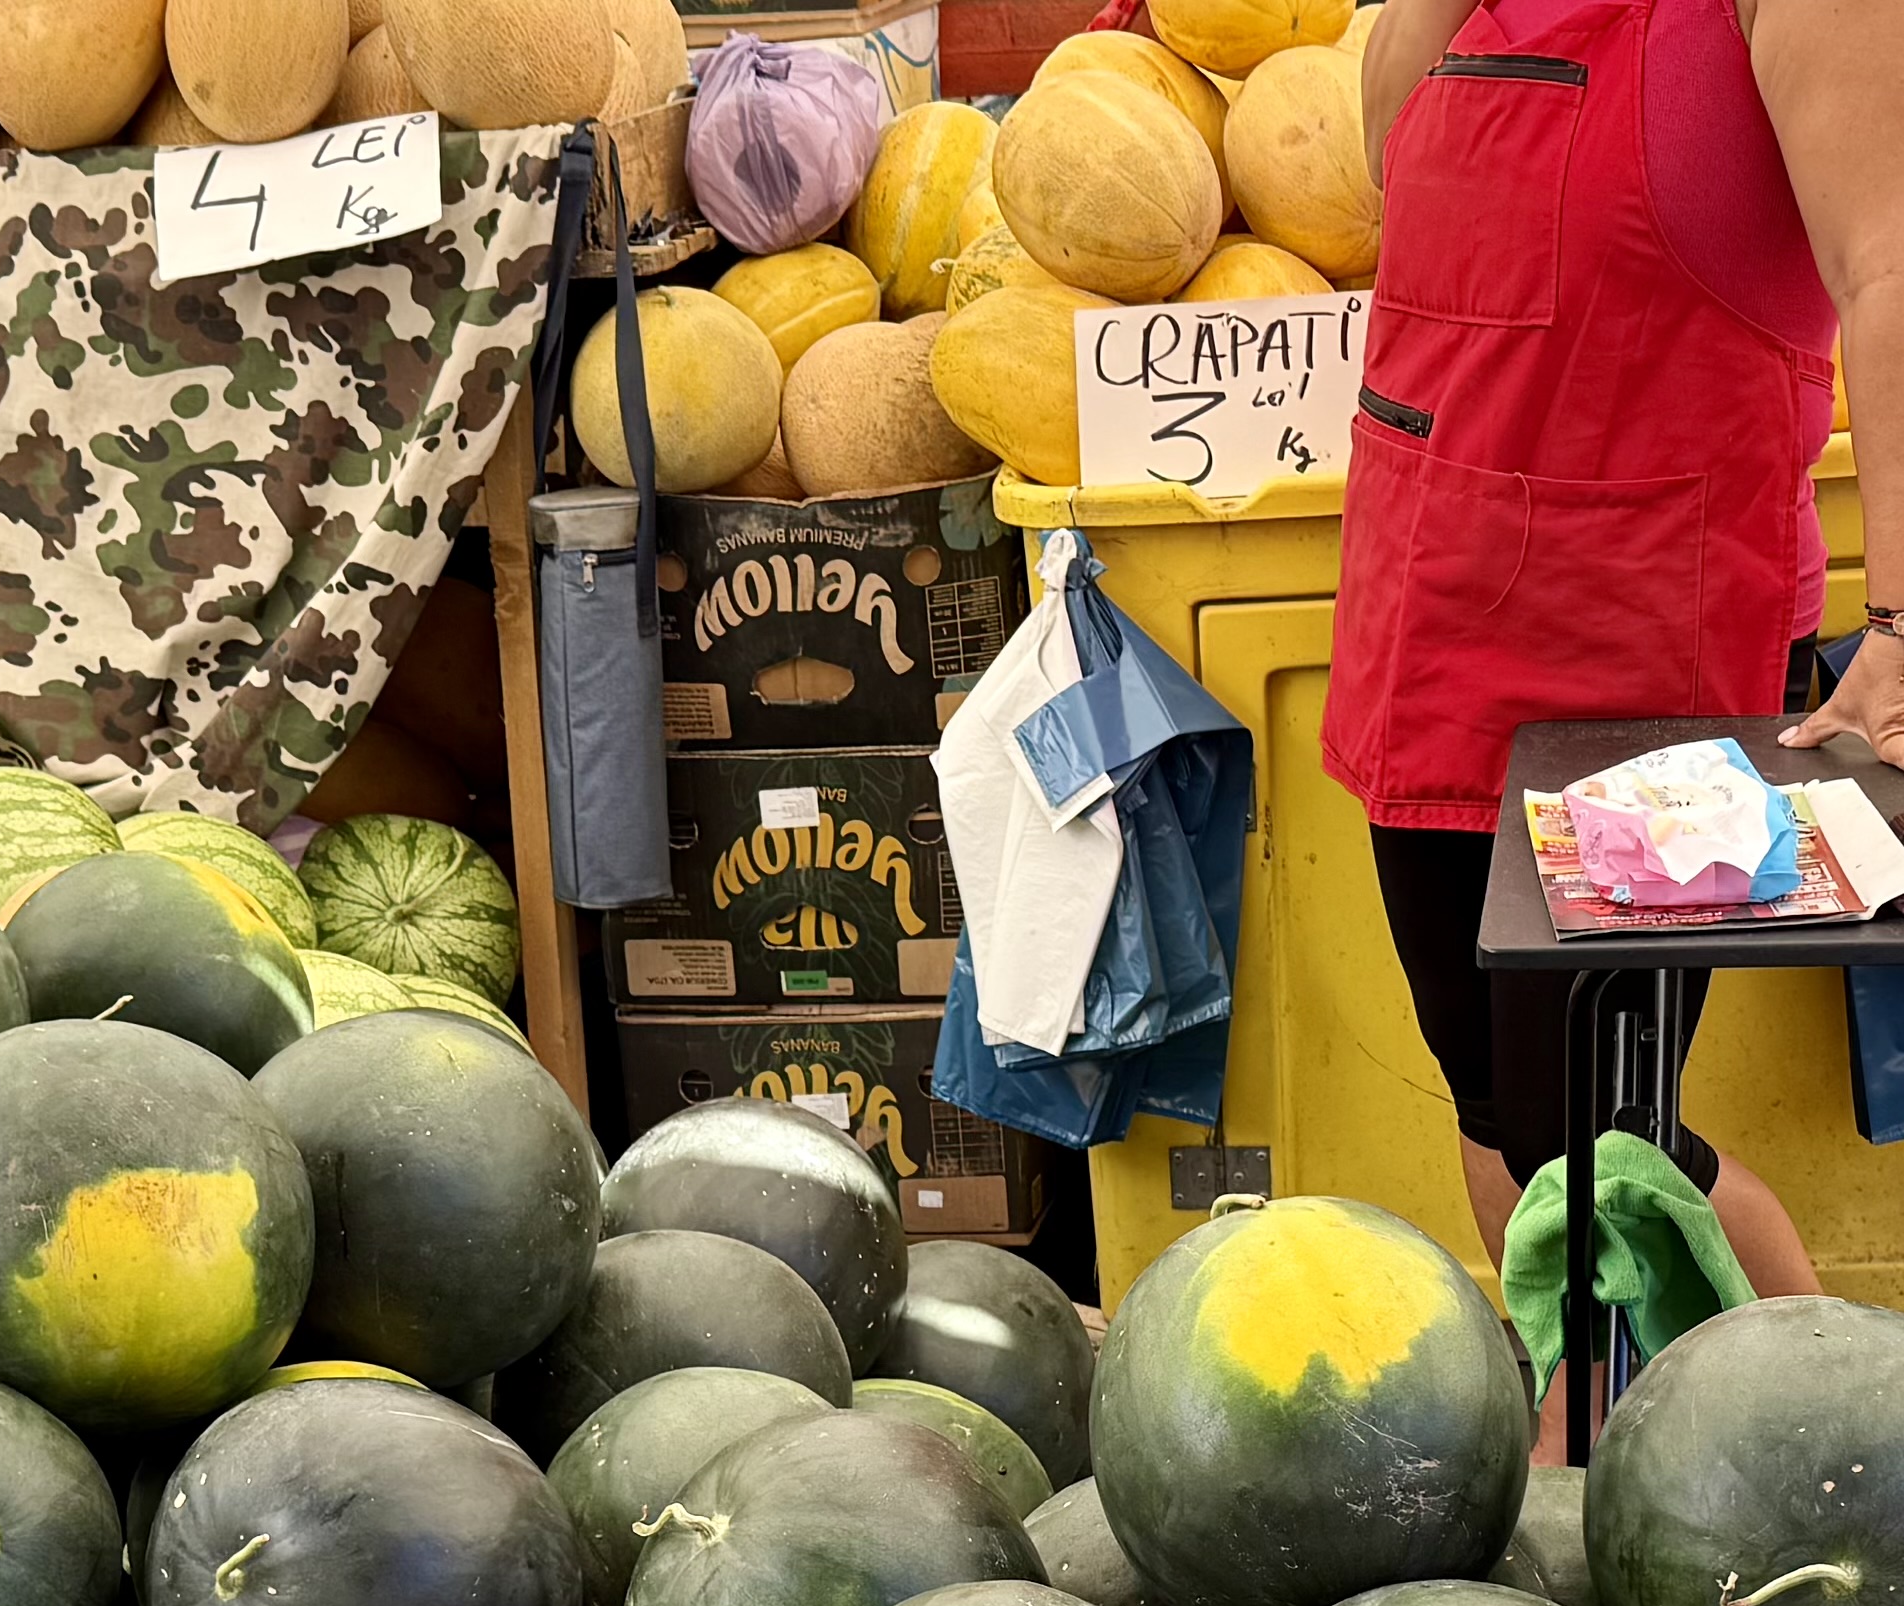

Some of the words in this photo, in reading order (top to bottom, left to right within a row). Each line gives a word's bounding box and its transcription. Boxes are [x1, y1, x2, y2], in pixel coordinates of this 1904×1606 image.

[191, 150, 268, 251] 4
[312, 114, 426, 168] LEI
[1147, 391, 1226, 486] 3
[716, 527, 788, 554] BANANAS
[791, 527, 869, 551] PREMIUM
[693, 553, 916, 676] yellow
[770, 1040, 841, 1055] BANANAS
